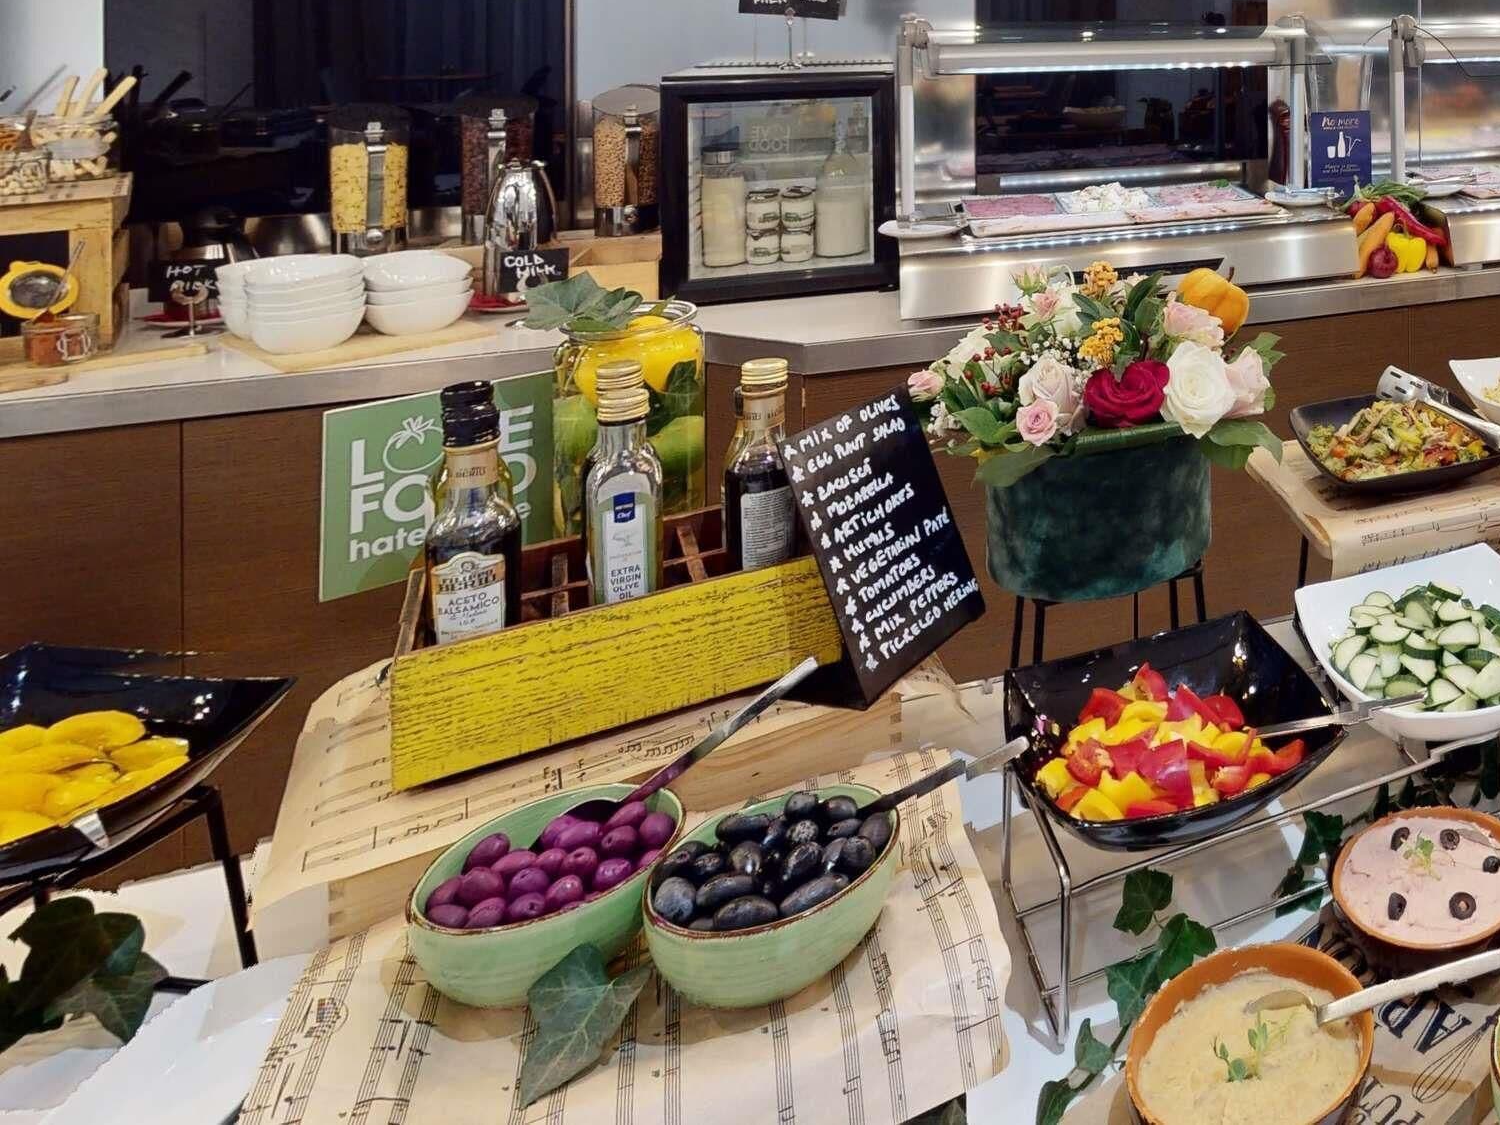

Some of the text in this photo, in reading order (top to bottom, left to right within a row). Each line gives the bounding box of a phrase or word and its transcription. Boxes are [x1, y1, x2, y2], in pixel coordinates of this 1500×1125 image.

[166, 264, 206, 278] HOT
[504, 254, 544, 268] COLD
[799, 394, 901, 453] MIX OF OLIVES
[351, 405, 534, 485] LOE
[806, 416, 906, 474] EGG PLANT SALAD
[350, 452, 537, 534] FOD
[350, 522, 426, 562] hate
[843, 521, 895, 562] HUMUS
[610, 573, 641, 586] VIRGIN
[611, 565, 640, 577] EXTRA
[612, 581, 640, 593] OLIVE
[858, 553, 920, 603] TOMATOES
[438, 596, 499, 615] BALSAMICO
[448, 592, 487, 606] ACETO
[619, 591, 634, 600] OIL
[866, 564, 936, 623] CUCUMBERS
[874, 571, 959, 640] MIX PEPPERS
